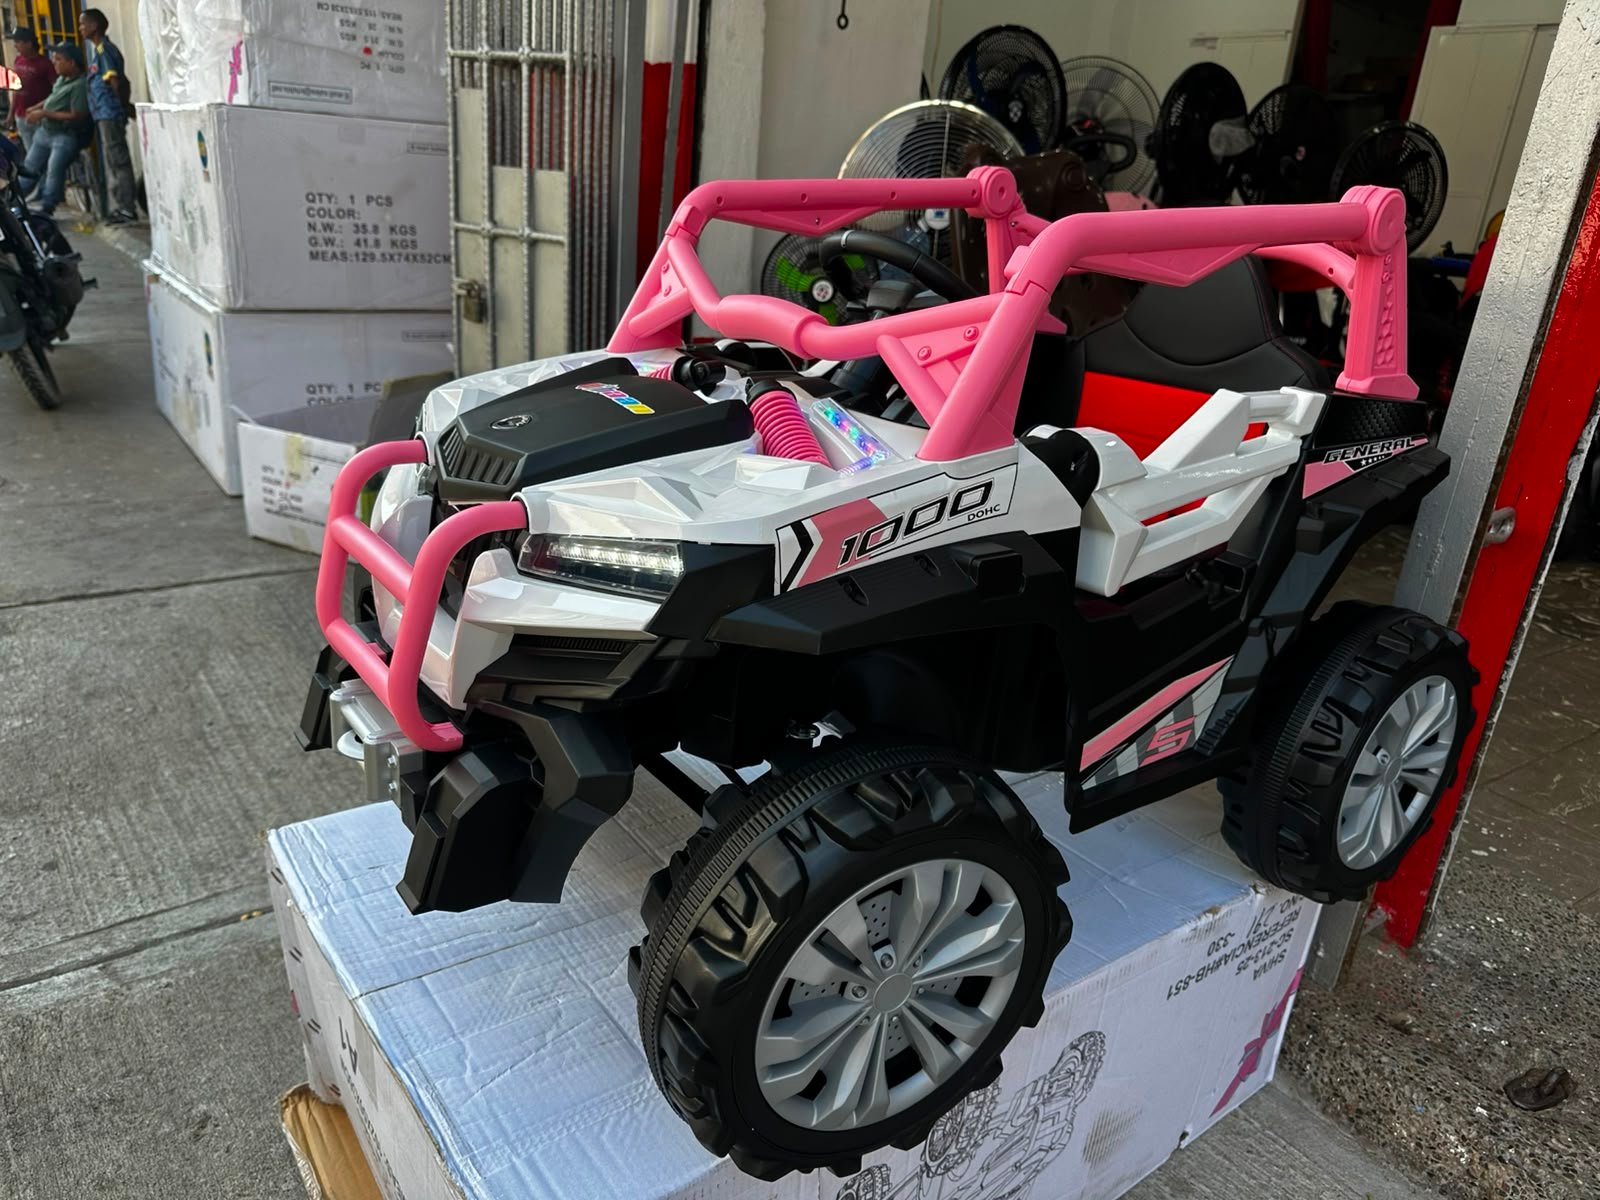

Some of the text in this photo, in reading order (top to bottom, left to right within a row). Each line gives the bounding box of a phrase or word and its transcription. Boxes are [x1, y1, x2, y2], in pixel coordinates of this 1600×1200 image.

[305, 192, 393, 207] QTY: 1 PCS
[306, 206, 361, 220] COLOR:
[388, 224, 417, 237] KGS
[390, 238, 418, 250] KGS
[1323, 437, 1415, 465] GENERAL
[967, 503, 1001, 522] DOHC
[837, 477, 994, 569] 1000
[1252, 949, 1287, 981] SHIVA
